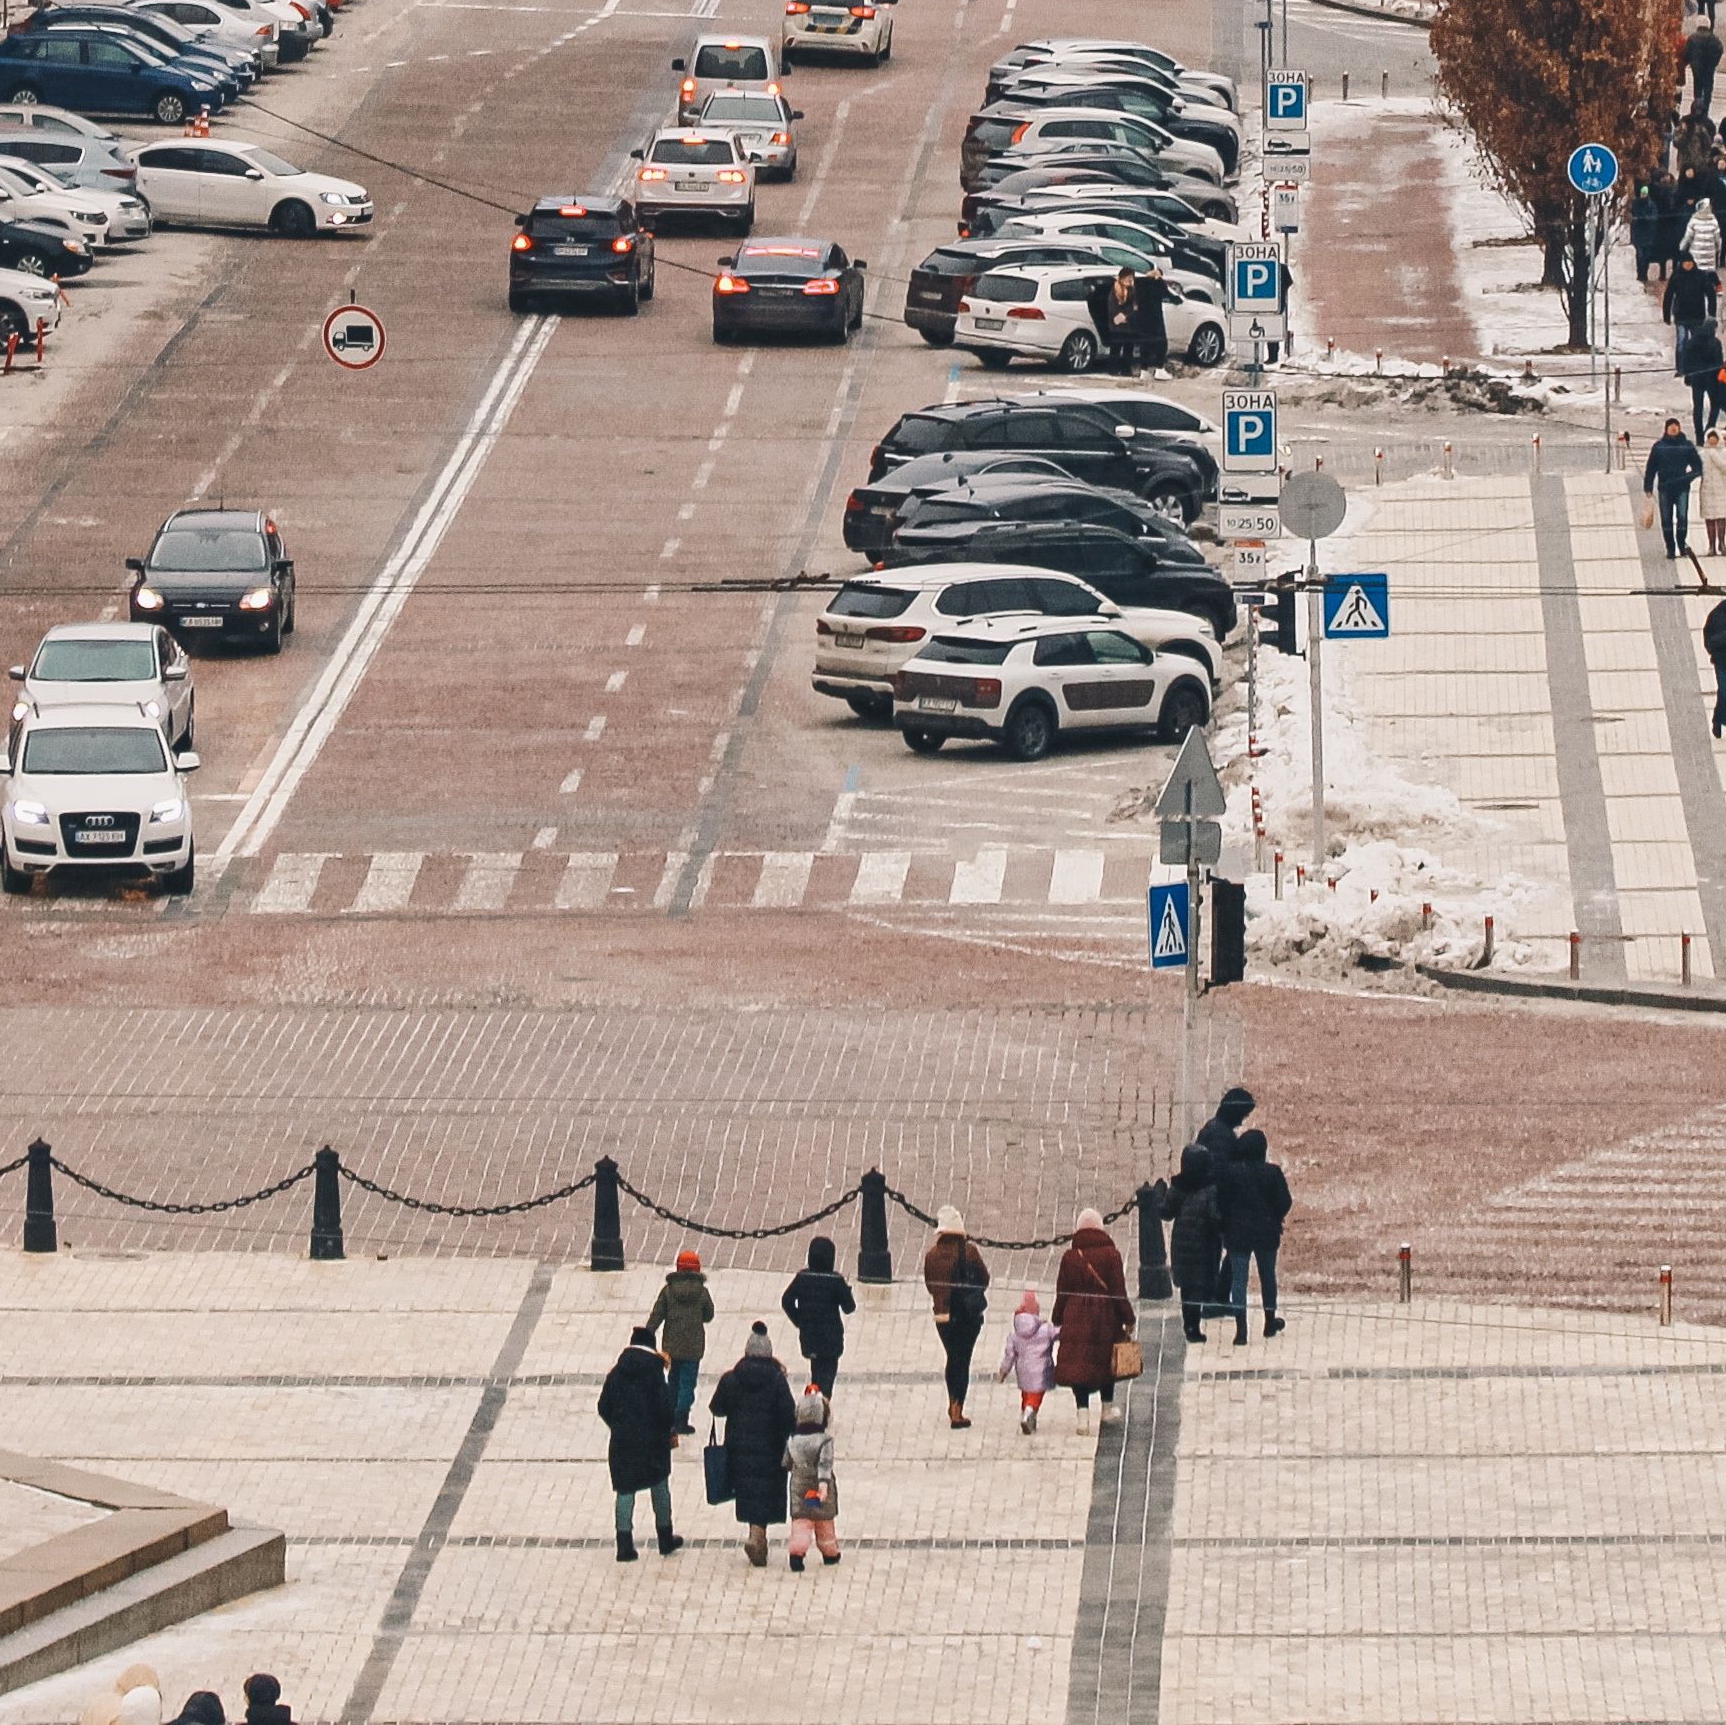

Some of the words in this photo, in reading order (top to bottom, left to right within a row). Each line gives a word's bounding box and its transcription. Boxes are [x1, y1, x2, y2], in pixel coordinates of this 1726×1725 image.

[1268, 72, 1305, 84] ЗОНА
[1277, 87, 1297, 116] P
[1235, 246, 1278, 259] ЗОНА
[1247, 264, 1269, 297] P
[1226, 394, 1274, 409] ЗОНА
[1238, 415, 1264, 453] P
[1238, 518, 1252, 529] 25
[1257, 517, 1274, 531] 50
